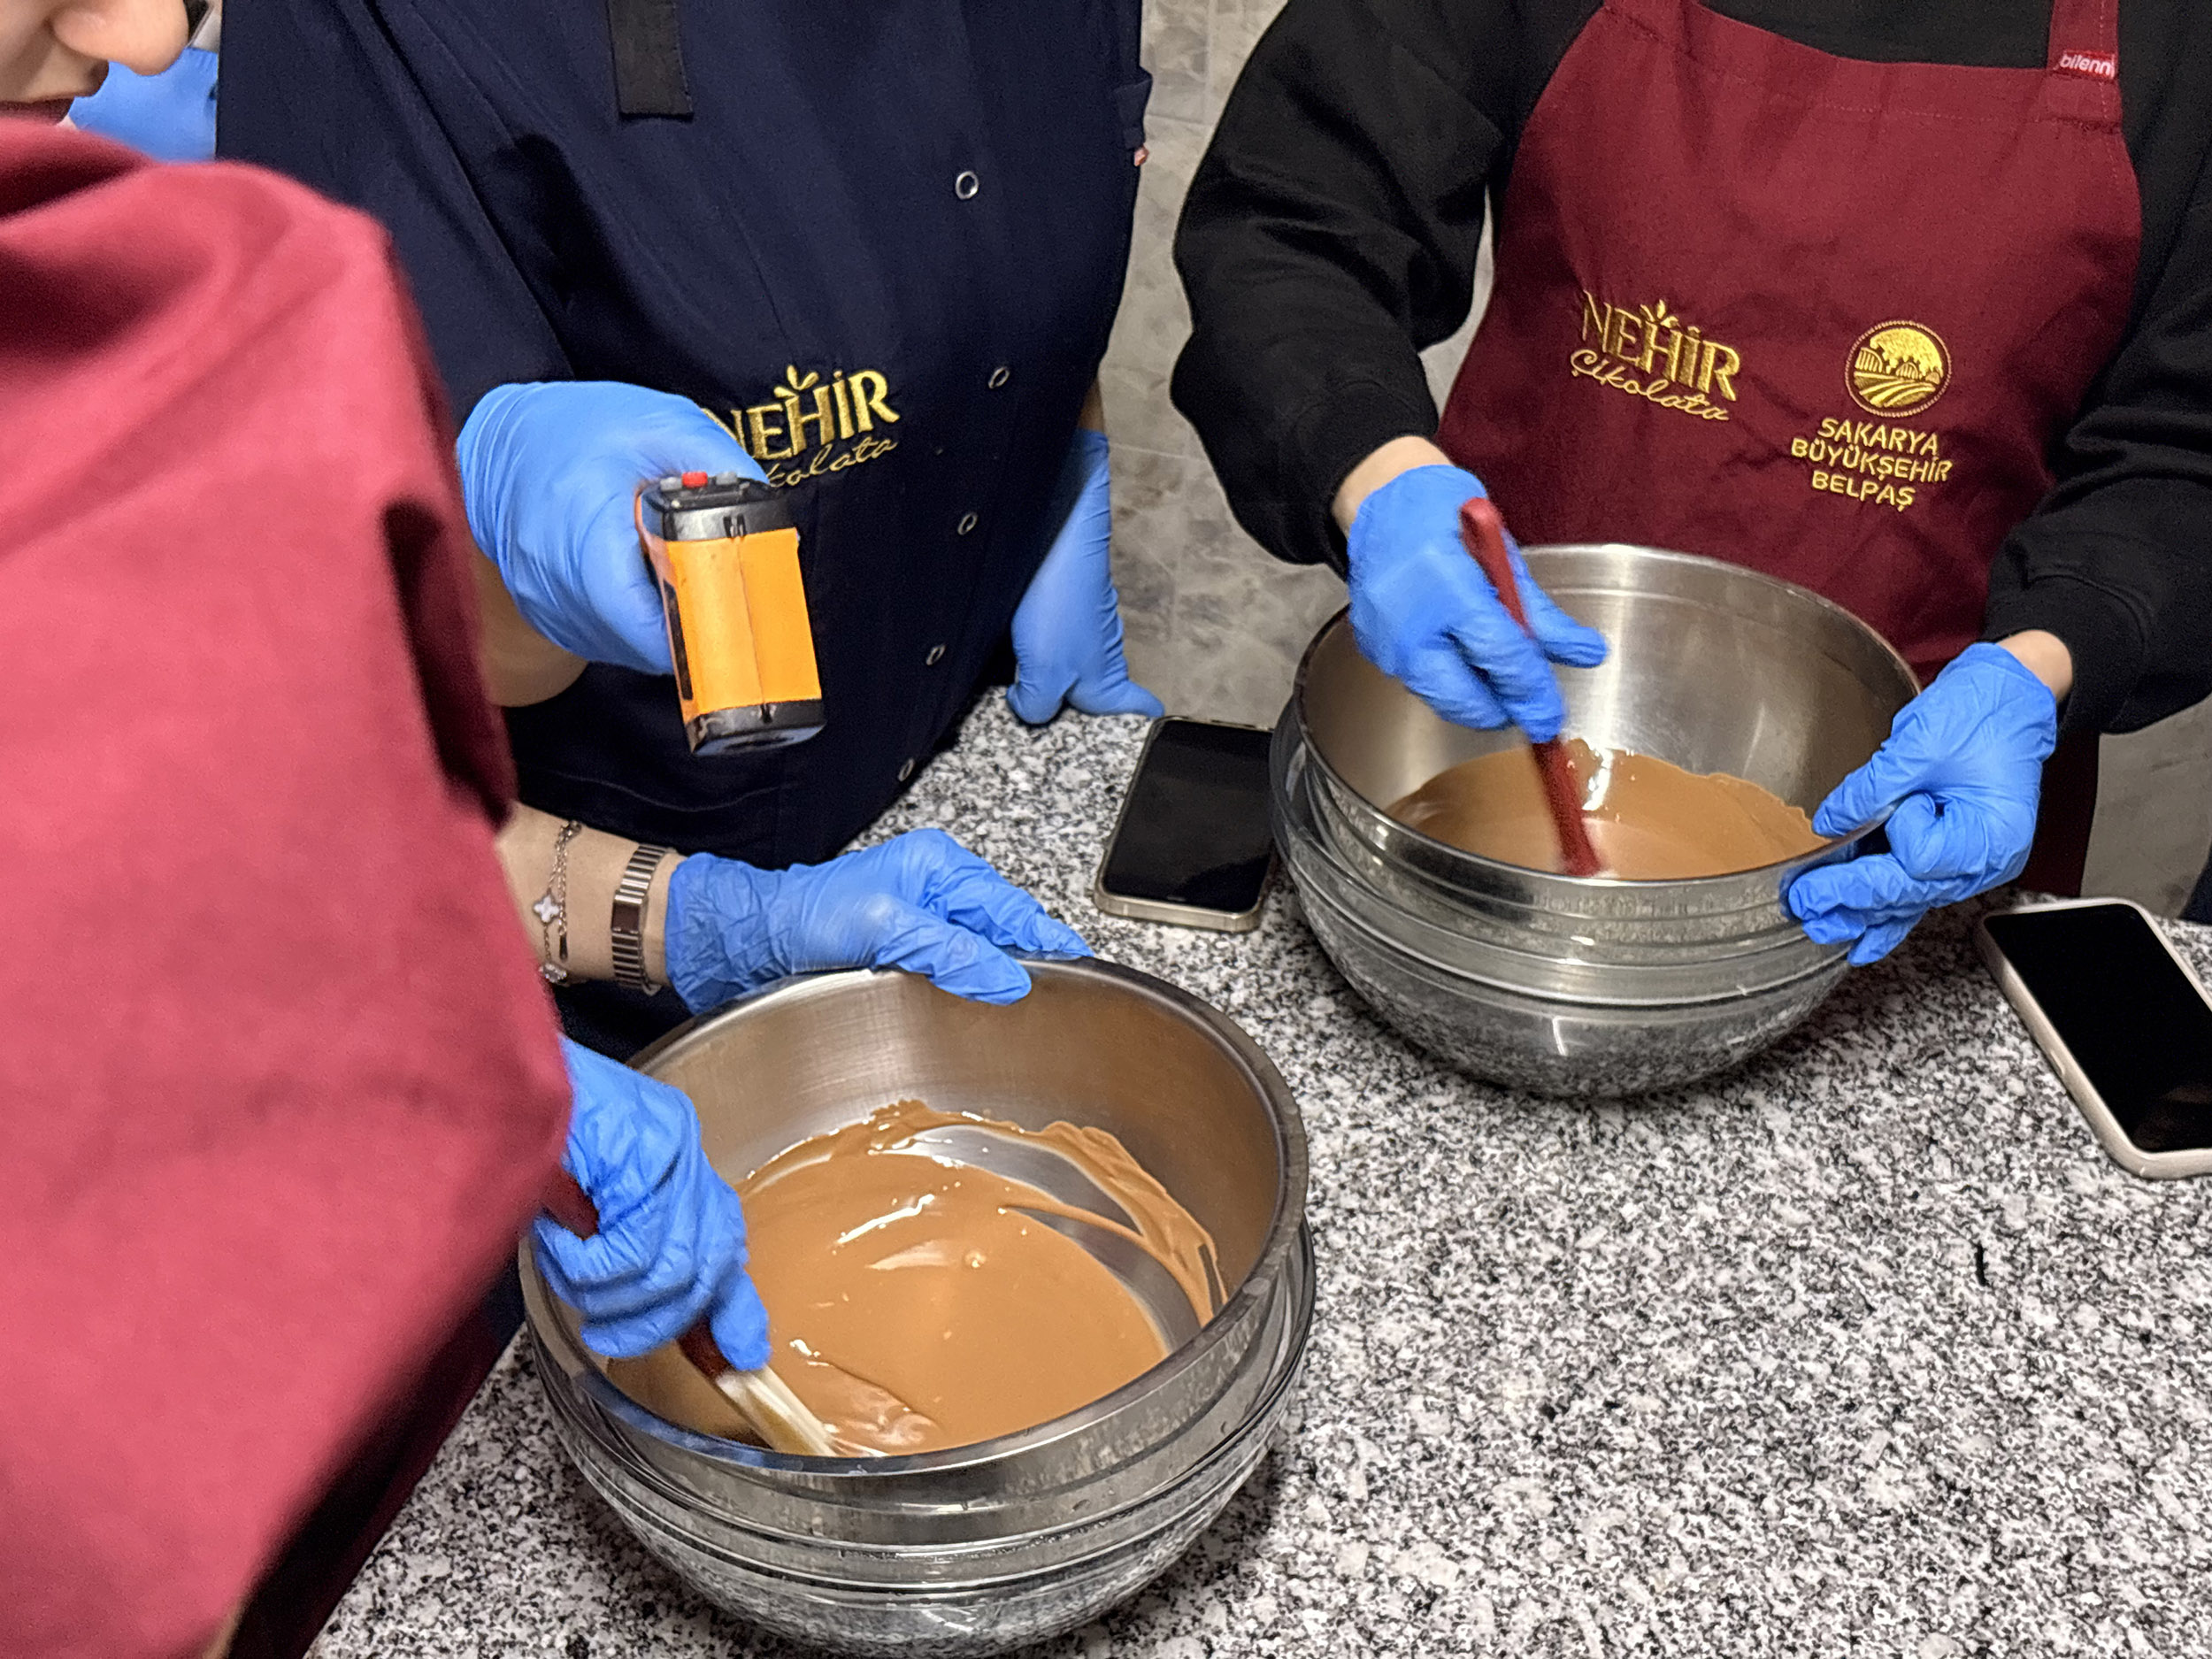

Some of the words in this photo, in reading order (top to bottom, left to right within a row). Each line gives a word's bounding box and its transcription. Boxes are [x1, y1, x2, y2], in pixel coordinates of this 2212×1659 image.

[1580, 288, 1740, 402] NEHİR
[1571, 349, 1730, 420] Çikolata
[766, 435, 898, 488] kolata
[1791, 437, 1954, 483] BÜYÜKŞEHİR
[1816, 417, 1939, 457] SAKARYA
[1811, 469, 1916, 512] BELPAŞ
